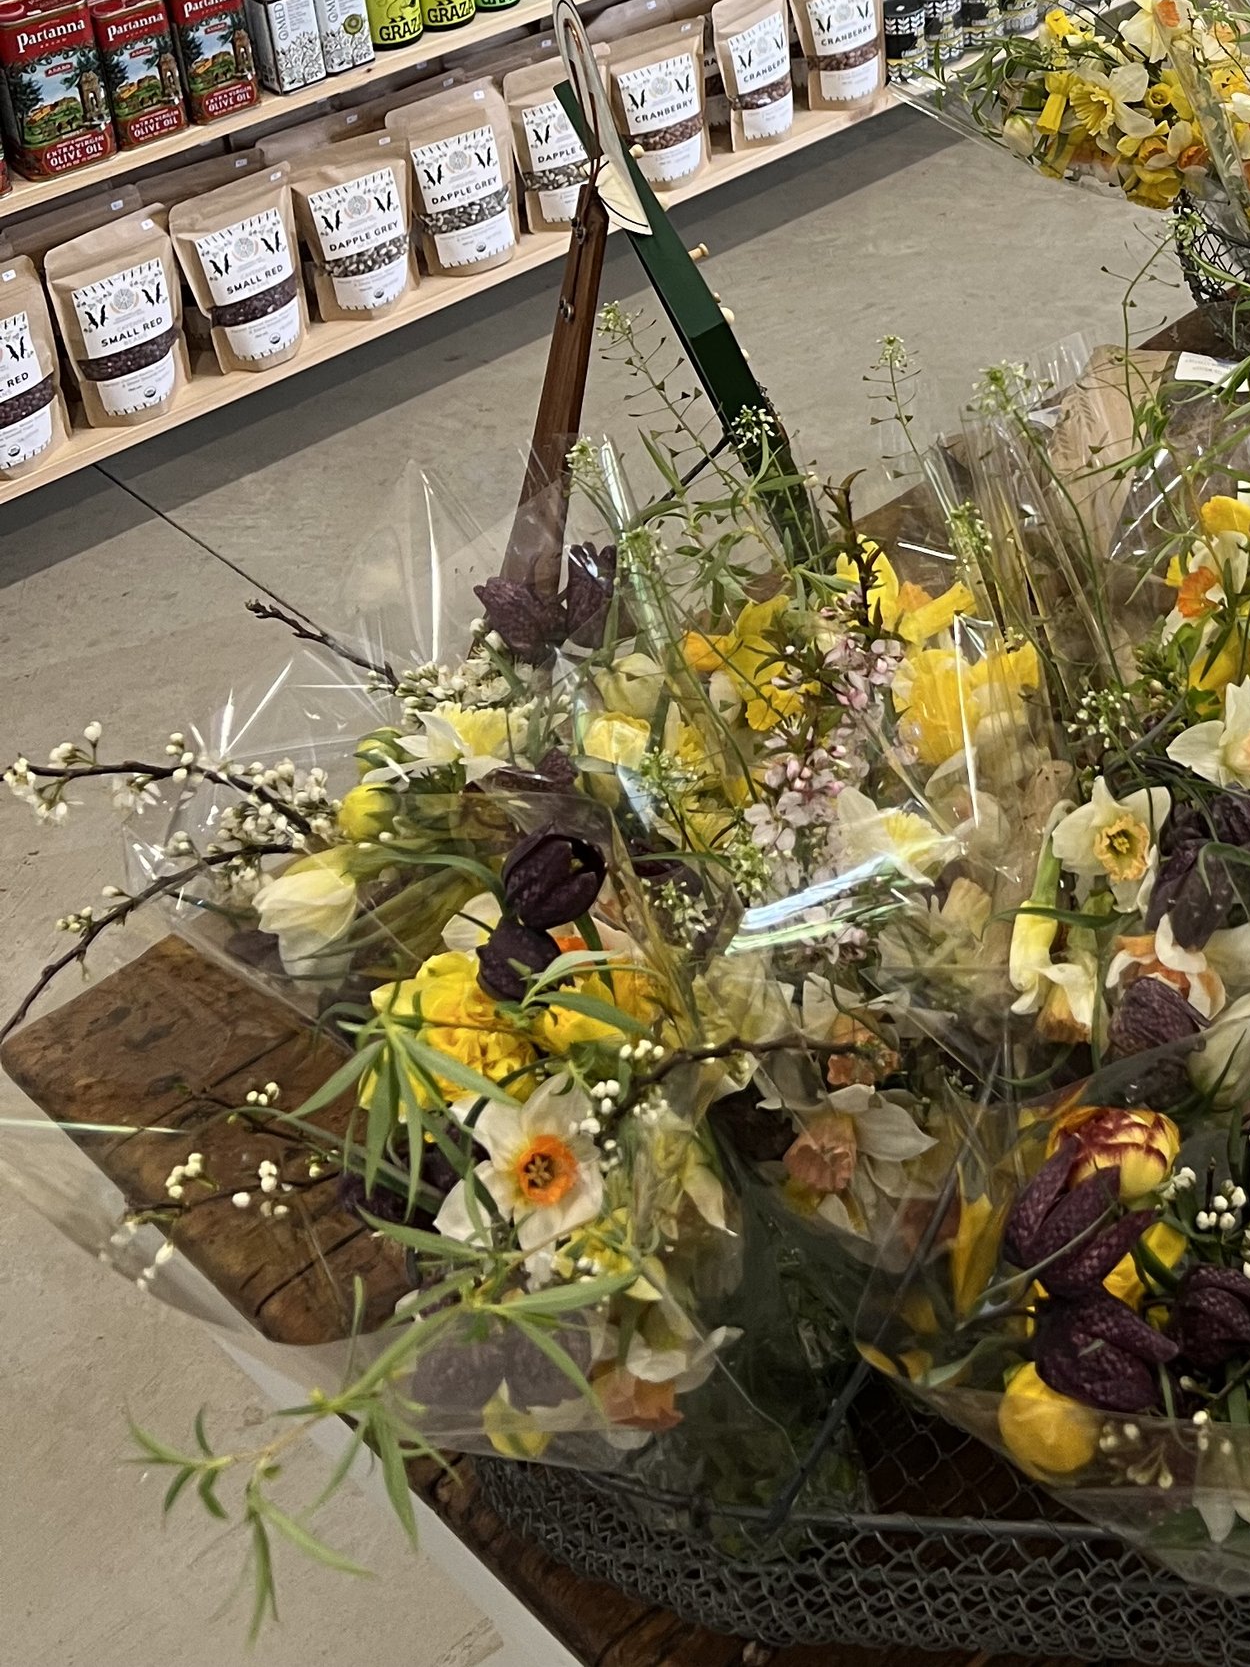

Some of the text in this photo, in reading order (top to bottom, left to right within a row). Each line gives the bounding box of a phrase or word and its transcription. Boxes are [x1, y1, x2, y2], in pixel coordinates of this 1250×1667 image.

[16, 18, 86, 53] Partanna
[107, 11, 164, 41] Partanna
[820, 24, 872, 47] CRANBERRY
[208, 92, 251, 112] OLIVE OIL
[635, 98, 694, 124] CRANBERRY
[133, 116, 178, 138] OLIVE OIL
[46, 134, 105, 159] EXTRA VIRGIN
[50, 143, 104, 167] OLIVE OIL
[537, 148, 576, 163] DAPPLE
[431, 176, 498, 205] DAPPLE GREY
[329, 220, 399, 252] DAPPLE GREY
[226, 264, 284, 295] SMALL RED
[101, 316, 163, 348] SMALL RED
[7, 371, 29, 389] RED
